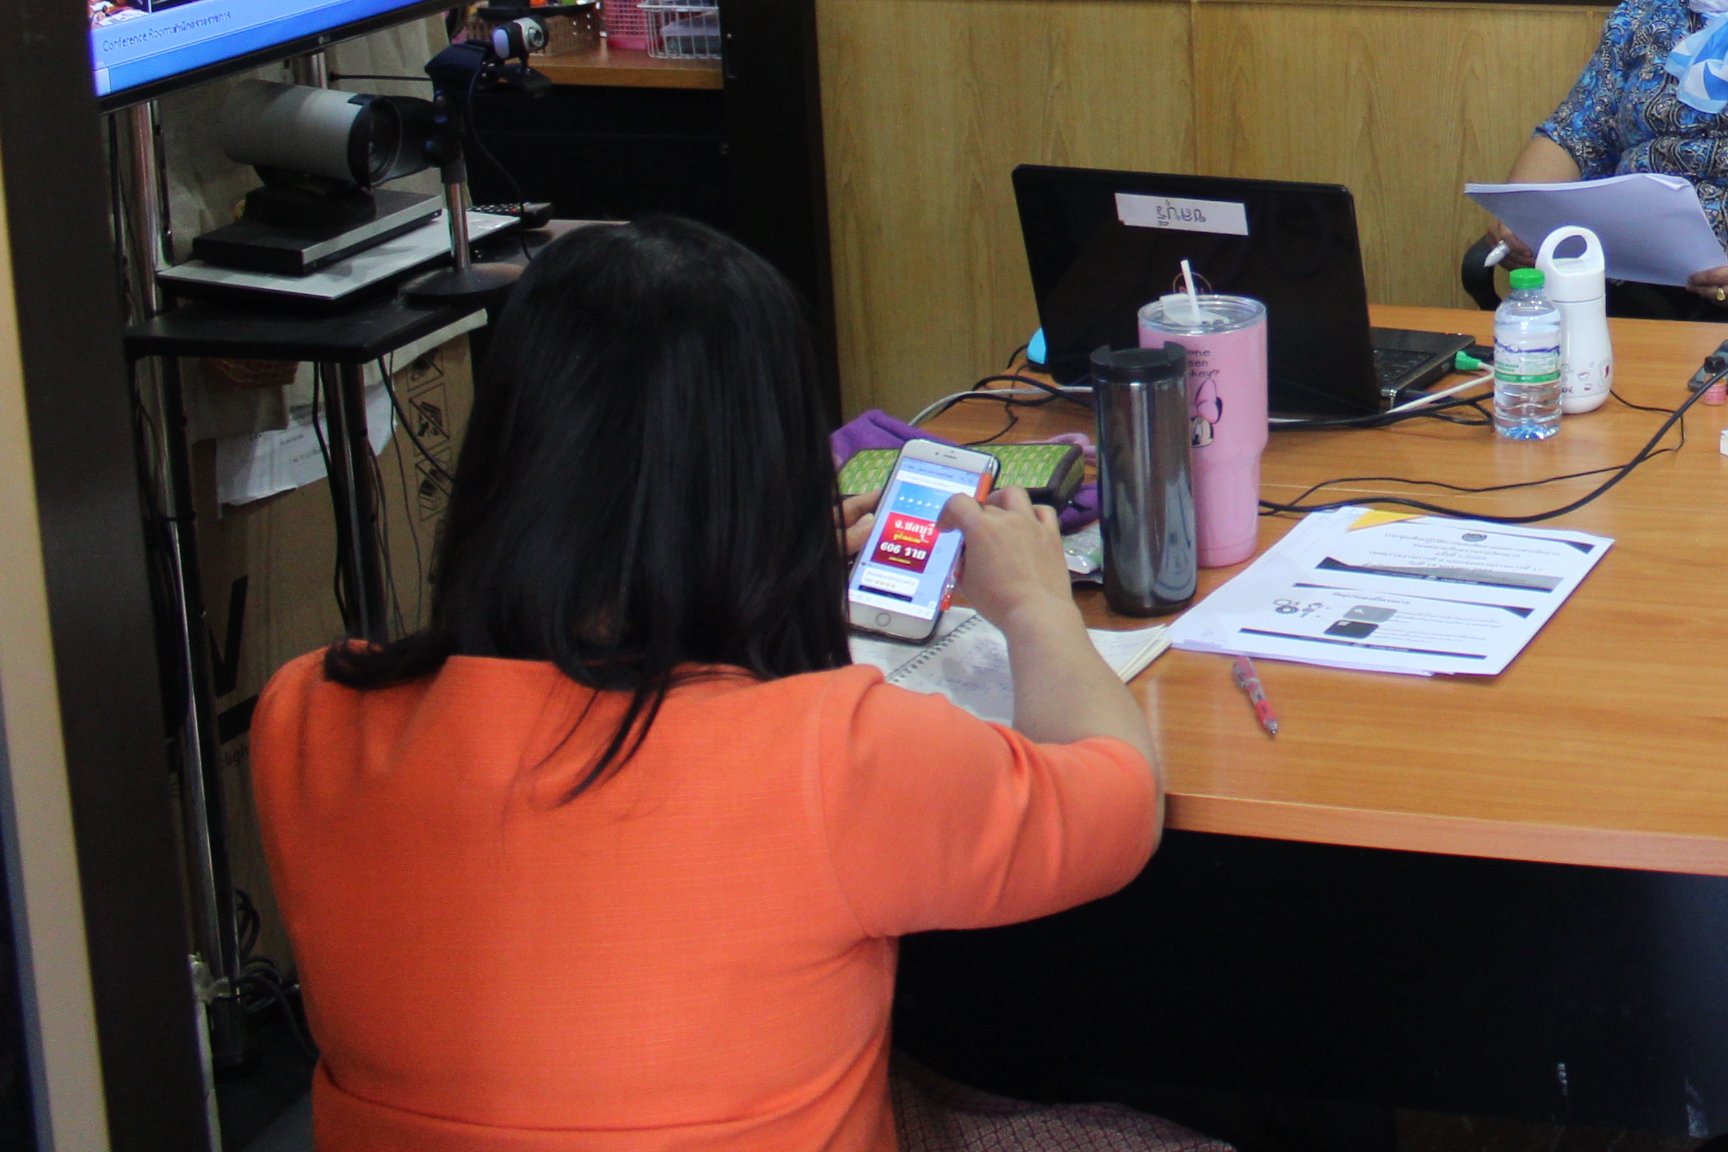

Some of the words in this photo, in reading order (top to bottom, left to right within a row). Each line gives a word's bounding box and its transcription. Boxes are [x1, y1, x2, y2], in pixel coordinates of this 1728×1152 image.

[102, 31, 147, 52] Conference
[1156, 199, 1207, 226] ชลบุรี
[894, 519, 936, 542] จ.ชลบุรี
[880, 541, 902, 555] 606
[904, 547, 927, 560] ราย
